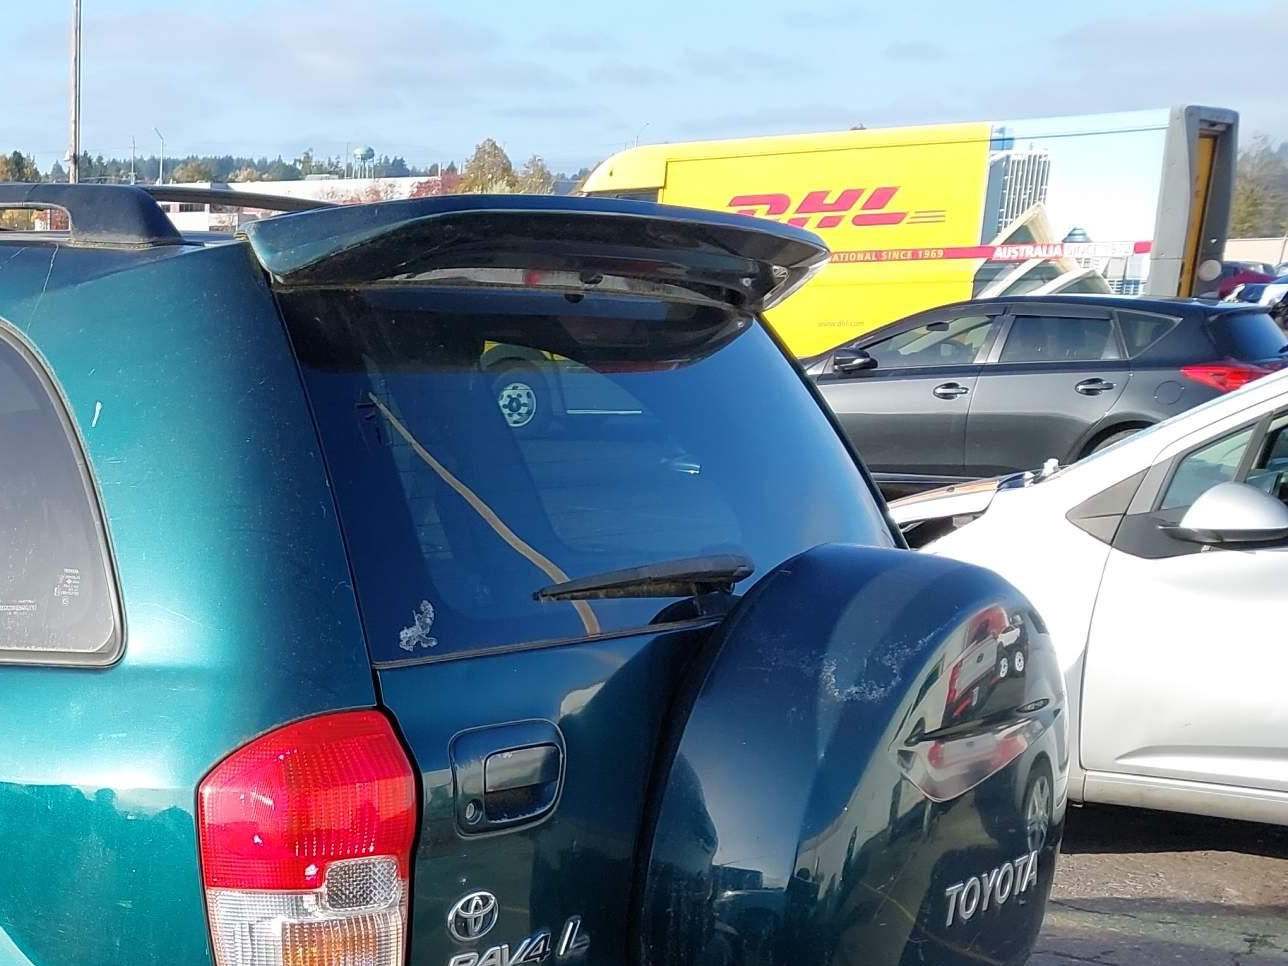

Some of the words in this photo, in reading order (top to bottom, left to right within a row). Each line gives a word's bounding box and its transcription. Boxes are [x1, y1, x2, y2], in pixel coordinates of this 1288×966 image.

[728, 186, 909, 229] DHL
[881, 250, 913, 260] SINCE
[918, 249, 944, 259] 1969
[993, 243, 1062, 259] AUSTRALIA
[945, 849, 1039, 928] TOYOTA
